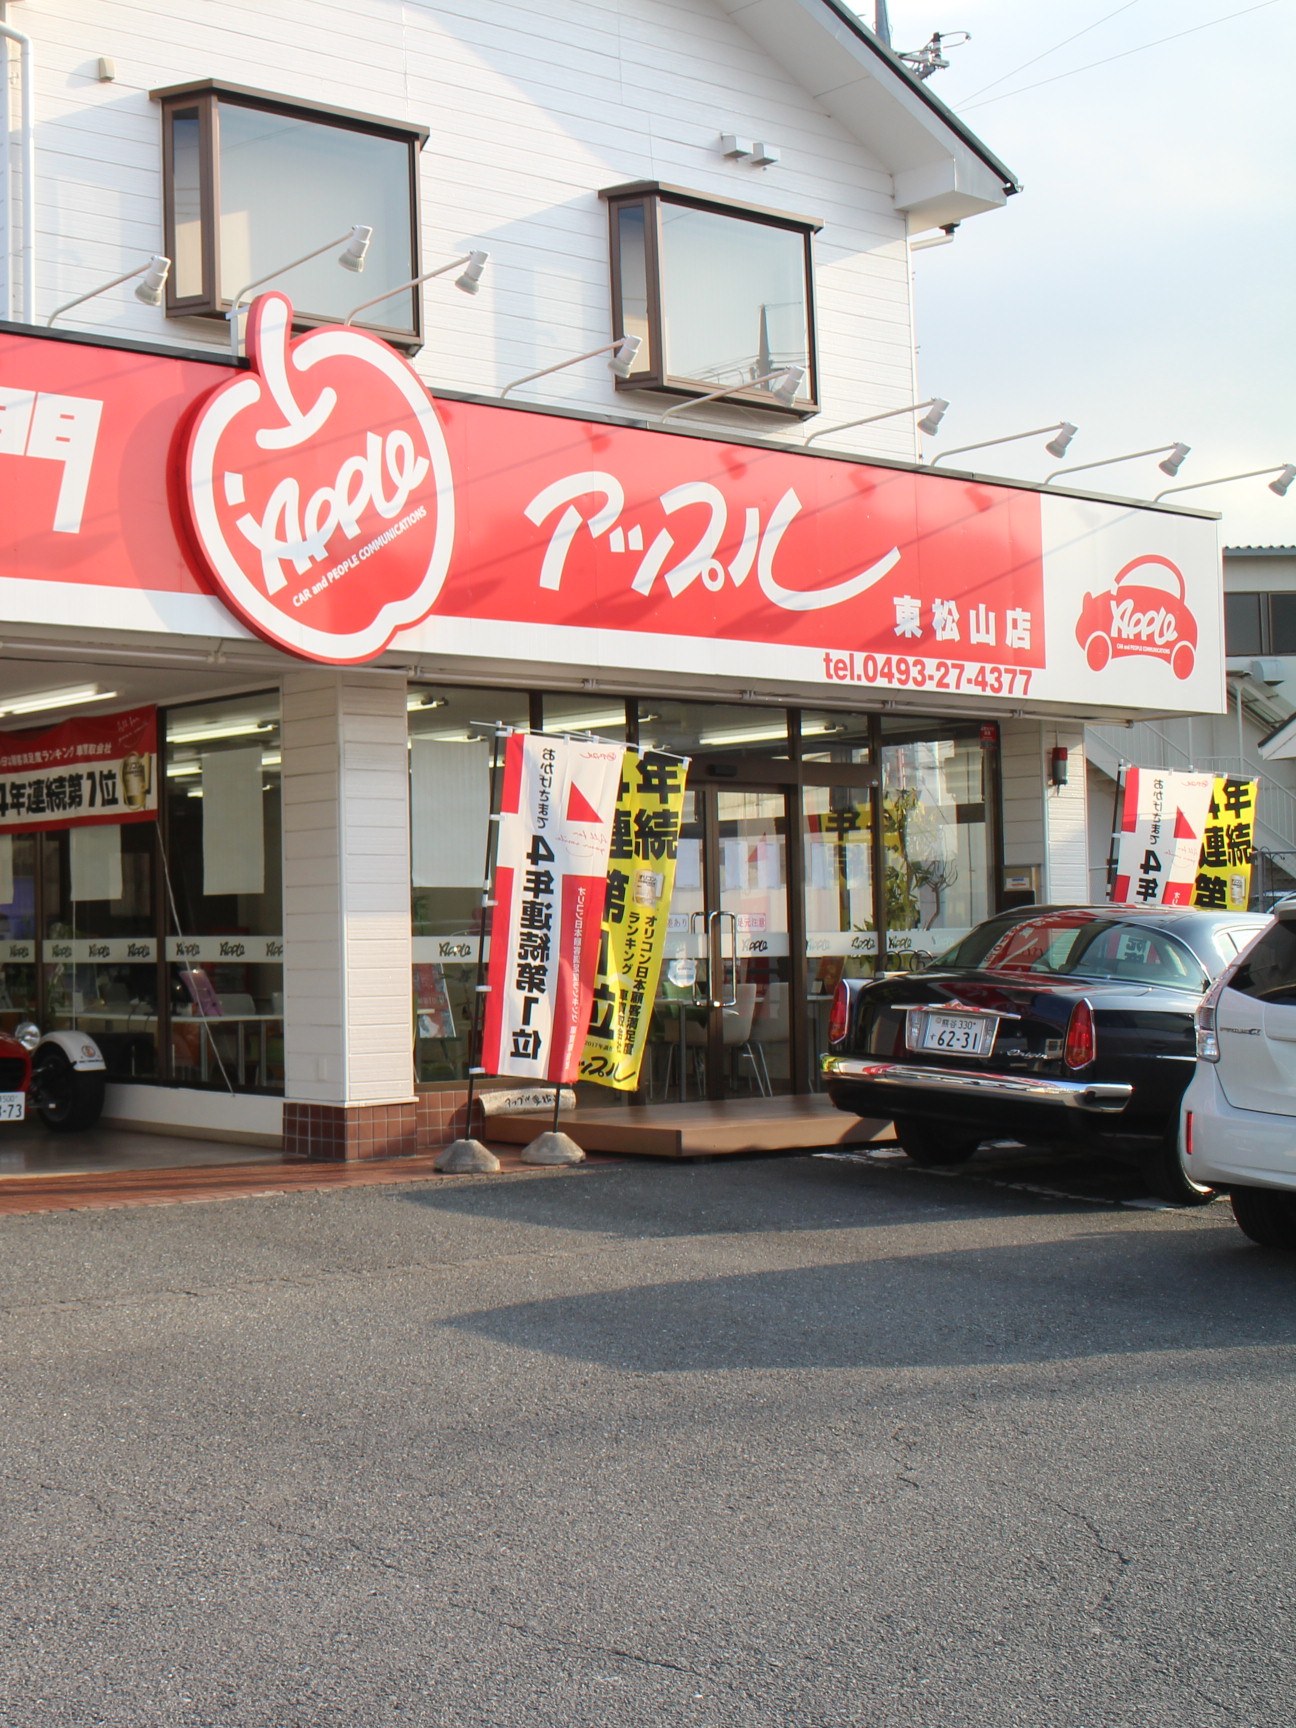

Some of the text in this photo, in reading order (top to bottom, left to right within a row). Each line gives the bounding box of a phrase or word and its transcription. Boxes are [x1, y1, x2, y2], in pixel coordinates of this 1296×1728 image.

[234, 430, 430, 597] Apple
[292, 505, 427, 607] CAR and PEOPLE COMMUNICATIONS
[524, 471, 902, 612] アップル
[893, 595, 1032, 650] 東松山店
[1110, 598, 1179, 646] Apple
[823, 652, 1033, 696] tel.0493-27-4377
[621, 912, 641, 975] ランキング
[937, 1030, 978, 1050] 62-31
[958, 1020, 973, 1030] 330
